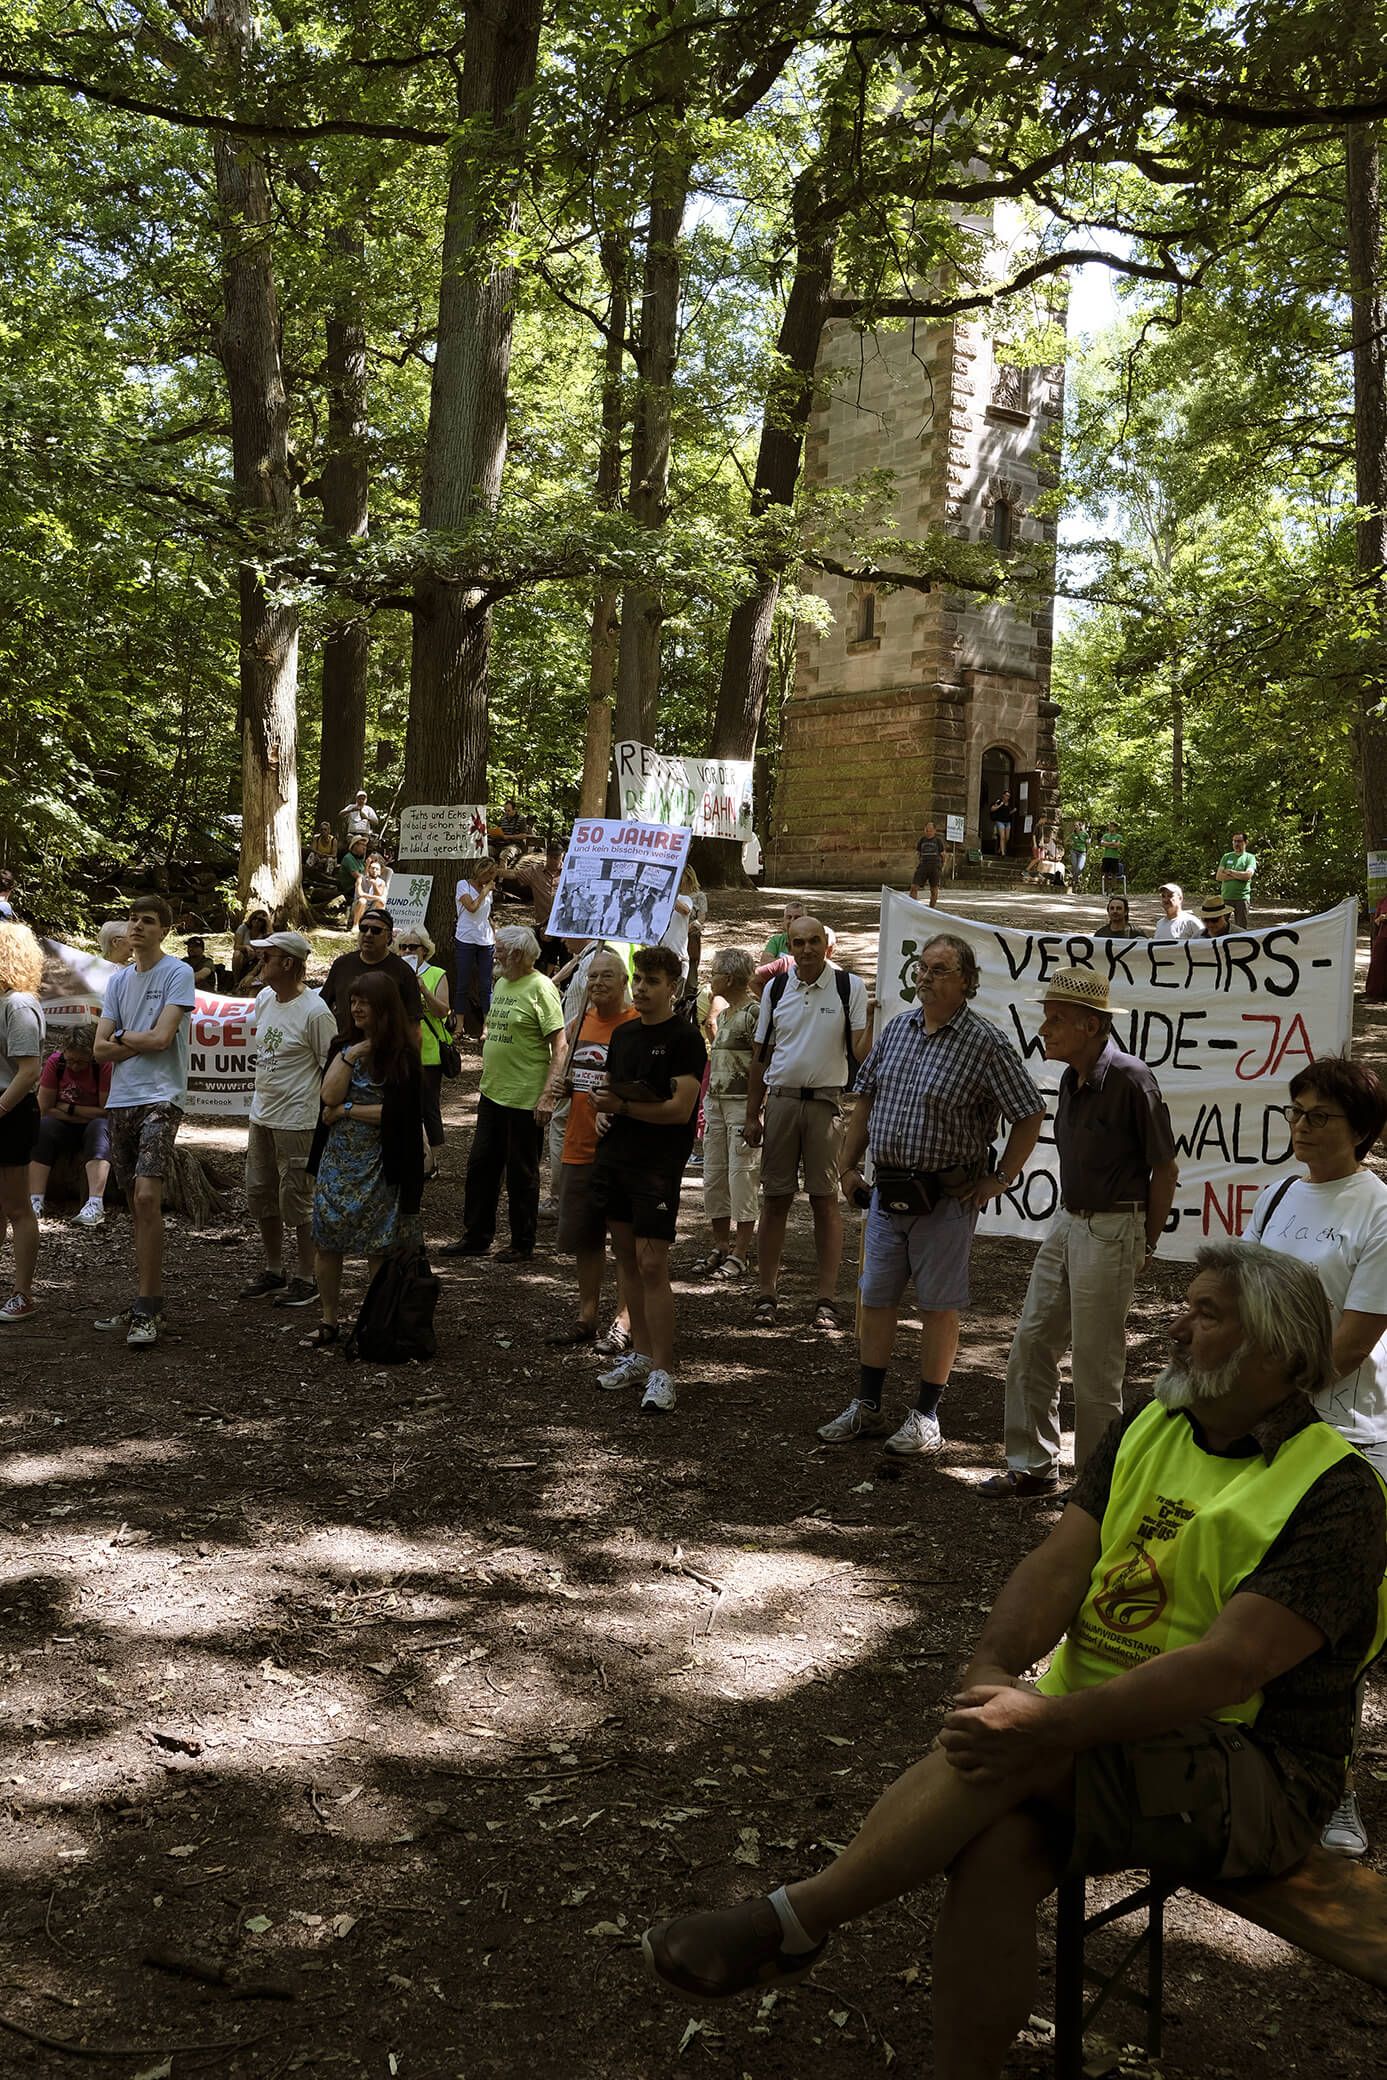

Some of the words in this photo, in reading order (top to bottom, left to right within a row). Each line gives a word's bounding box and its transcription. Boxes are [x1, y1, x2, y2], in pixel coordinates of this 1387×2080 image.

[703, 792, 737, 821] BAHN
[429, 820, 454, 830] schon
[443, 831, 467, 841] Bahn
[576, 826, 605, 845] 50
[610, 827, 685, 852] JAHRE
[574, 844, 590, 853] und
[592, 844, 609, 853] kein
[611, 846, 650, 856] bisschen
[651, 850, 681, 861] weiser
[386, 897, 409, 906] BUND
[389, 908, 422, 917] aturschutz
[993, 928, 1333, 998] VERKEHRS-
[205, 1081, 257, 1091] www.re
[196, 1097, 232, 1105] Facebook
